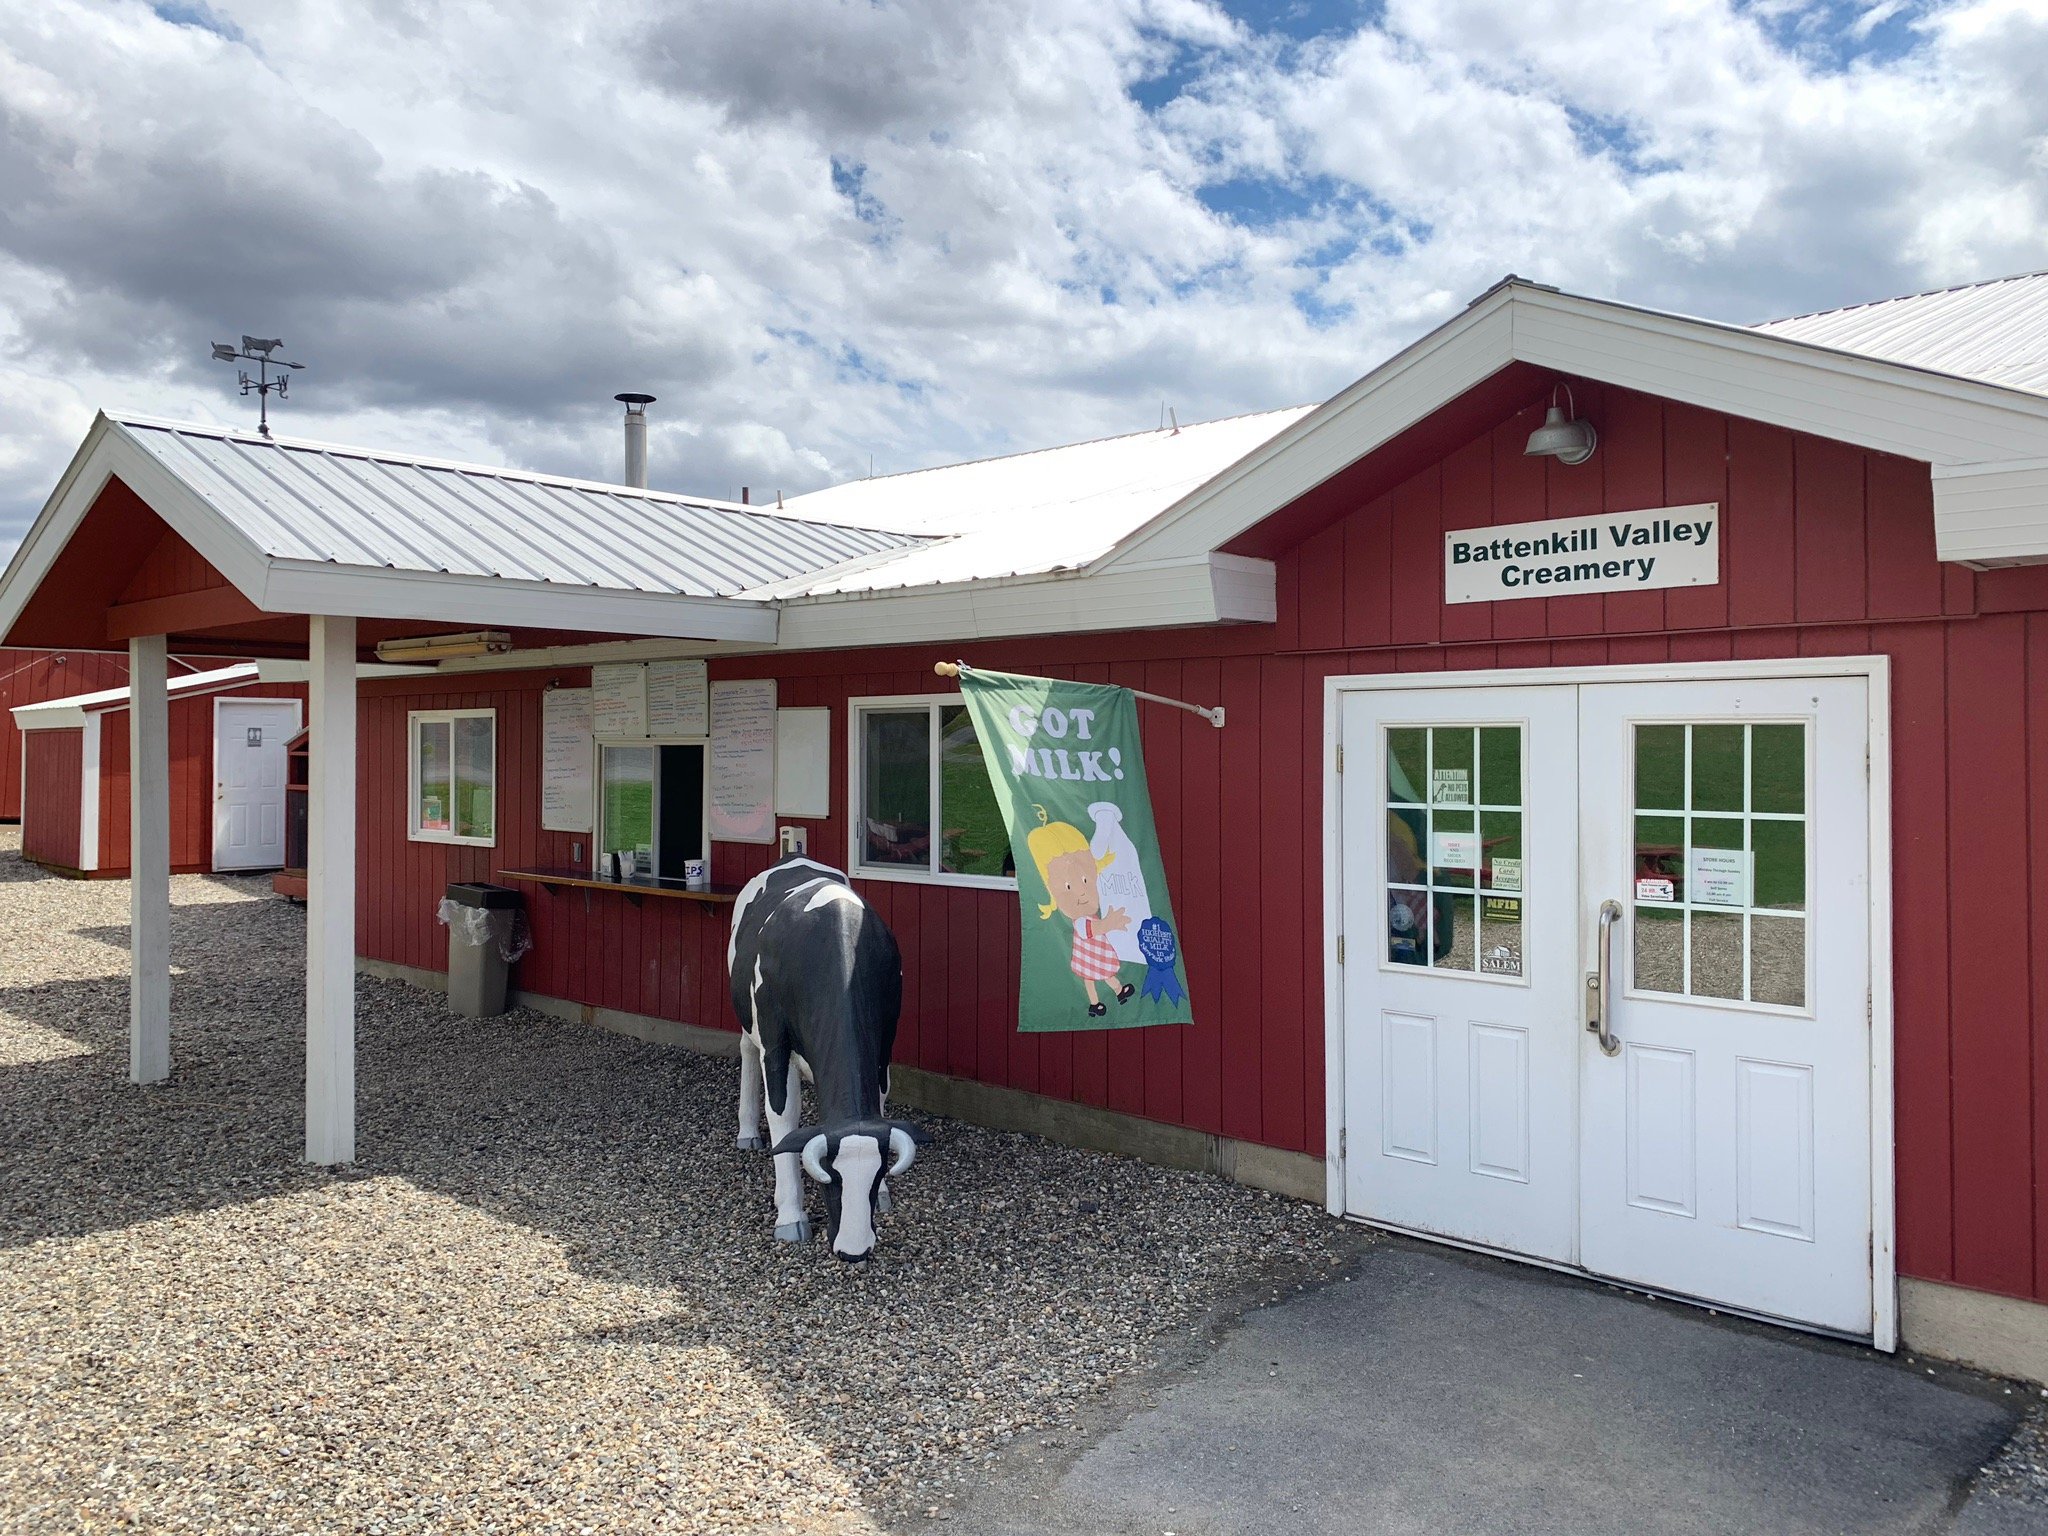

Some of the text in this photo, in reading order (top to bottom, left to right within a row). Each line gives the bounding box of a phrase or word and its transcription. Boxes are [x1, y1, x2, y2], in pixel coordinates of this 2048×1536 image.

[1453, 520, 1713, 564] Battenkill Valley
[1501, 557, 1656, 587] Creamery
[1008, 705, 1095, 740] GOT
[1007, 744, 1124, 781] MILK!
[1434, 769, 1467, 781] ATTENTION
[1448, 783, 1467, 792] NO PETS
[1444, 793, 1467, 802] ALLOWED
[1099, 872, 1145, 898] MILK
[1494, 875, 1519, 884] Accepted
[1486, 898, 1518, 910] NFIB
[1152, 923, 1160, 931] #1
[1141, 929, 1172, 938] HIGHEST
[1142, 936, 1173, 945] QUALITY
[1149, 942, 1169, 951] MILK
[1482, 957, 1522, 971] SALEM
